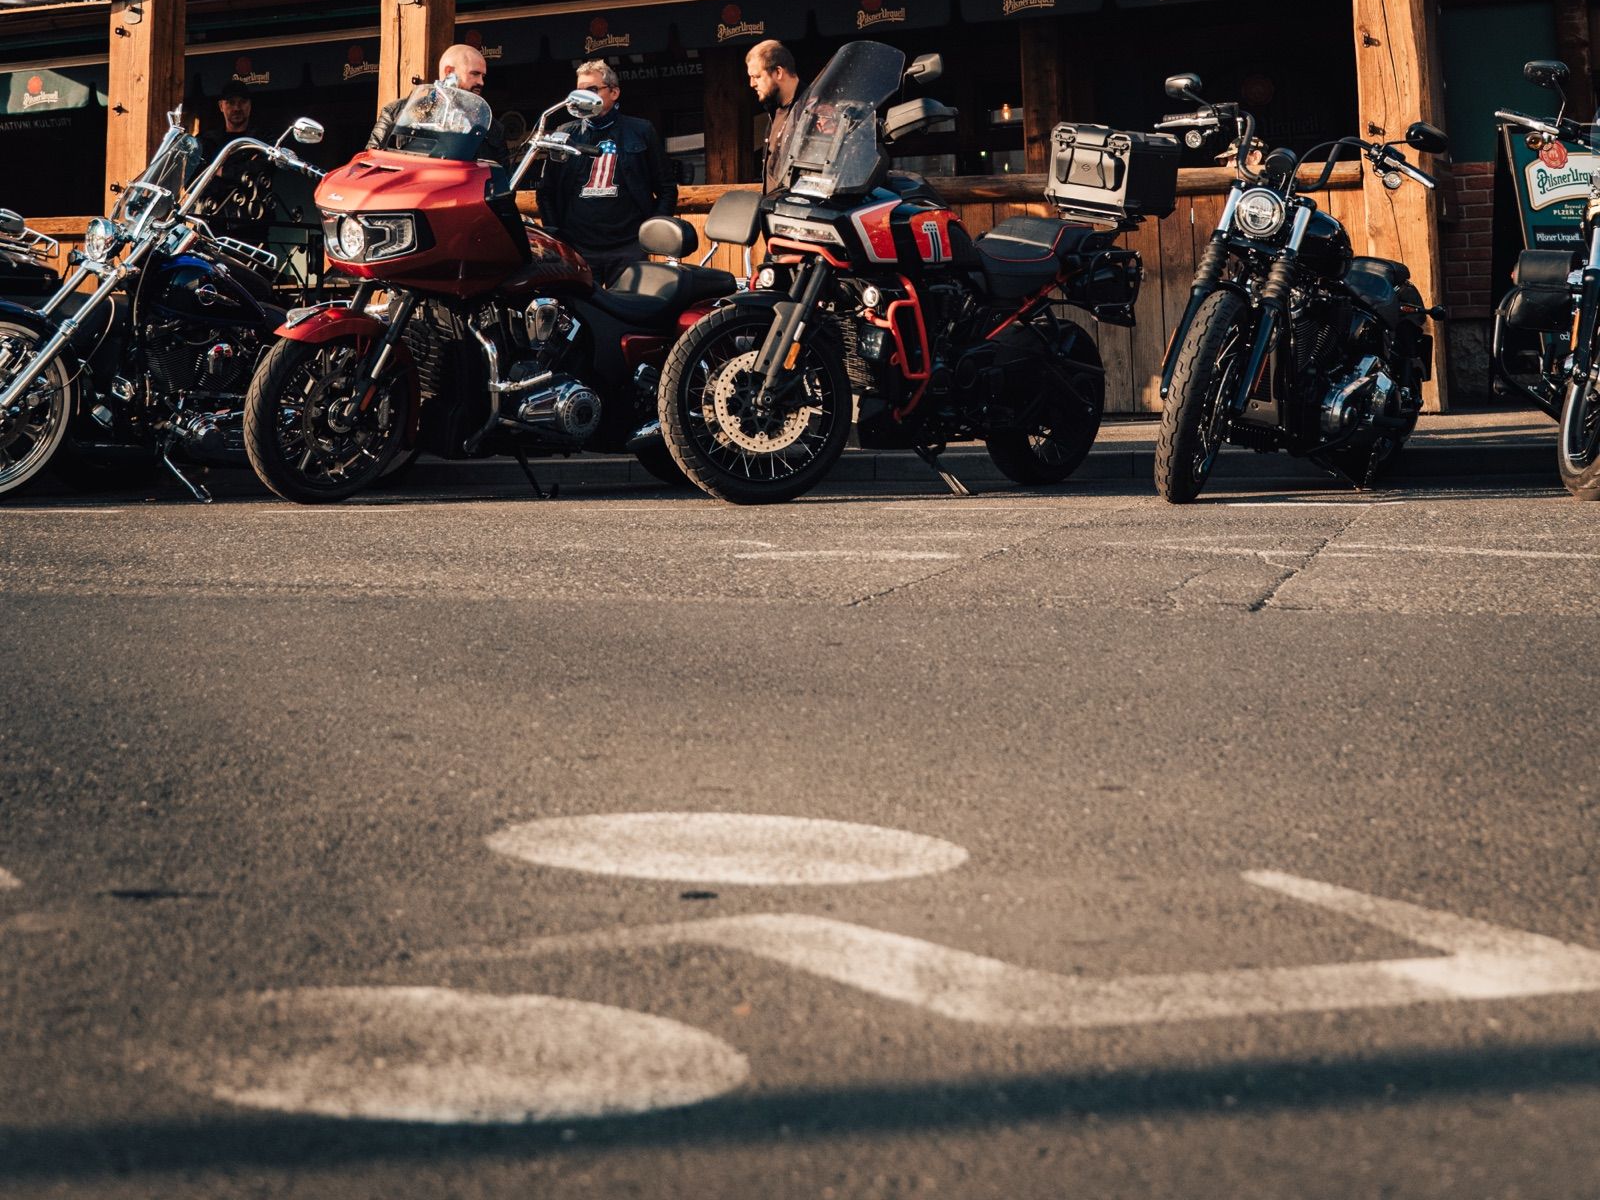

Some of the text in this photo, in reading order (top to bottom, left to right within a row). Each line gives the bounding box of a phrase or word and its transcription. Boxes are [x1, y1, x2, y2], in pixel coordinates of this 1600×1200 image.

[857, 8, 905, 29] Pilsner Urquell
[718, 21, 764, 42] Pilsner Urquell
[585, 33, 629, 54] Pilsner Urquell
[1537, 168, 1571, 194] Pilsner
[1536, 233, 1557, 241] Pilsner
